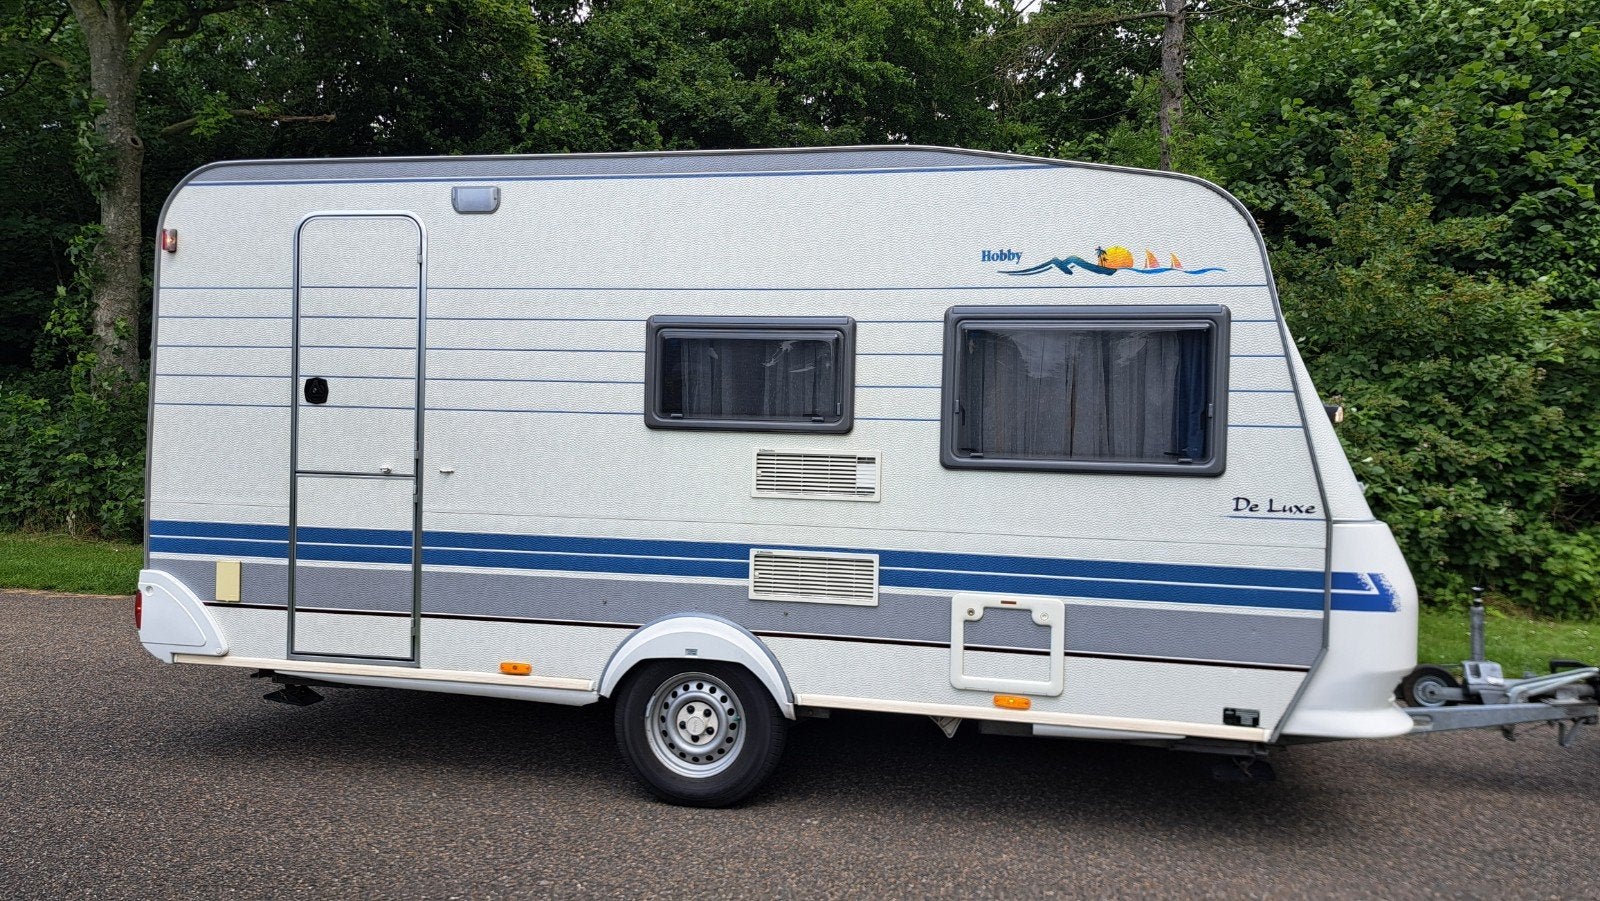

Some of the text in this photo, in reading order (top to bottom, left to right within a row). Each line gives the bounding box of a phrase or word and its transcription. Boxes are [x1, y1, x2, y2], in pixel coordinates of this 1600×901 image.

[981, 249, 1023, 264] Hobby
[1232, 496, 1317, 515] De Luxe
